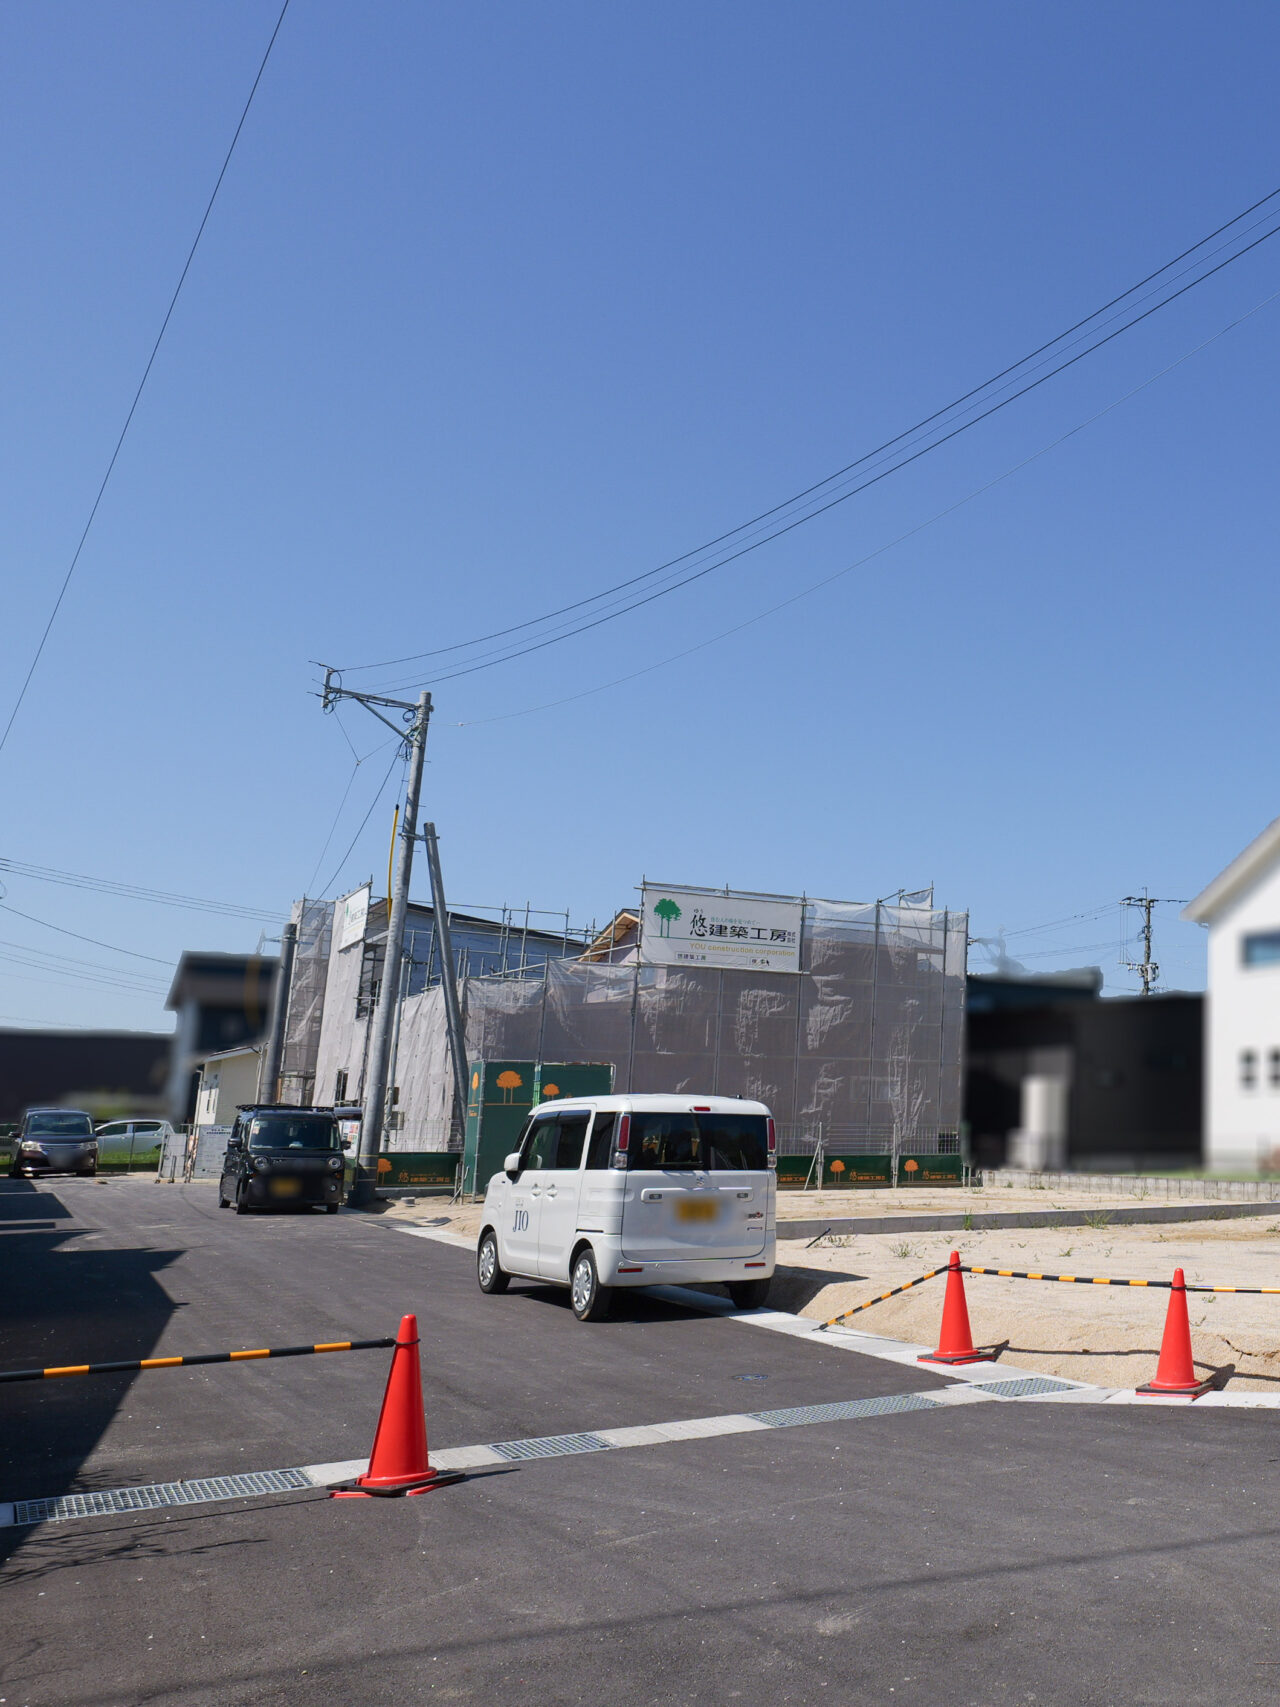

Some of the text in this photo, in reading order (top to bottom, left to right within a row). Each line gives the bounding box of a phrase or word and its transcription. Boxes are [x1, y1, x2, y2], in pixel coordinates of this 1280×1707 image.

[708, 944, 753, 953] construction
[755, 947, 795, 956] corporation
[513, 1210, 529, 1232] JIO
